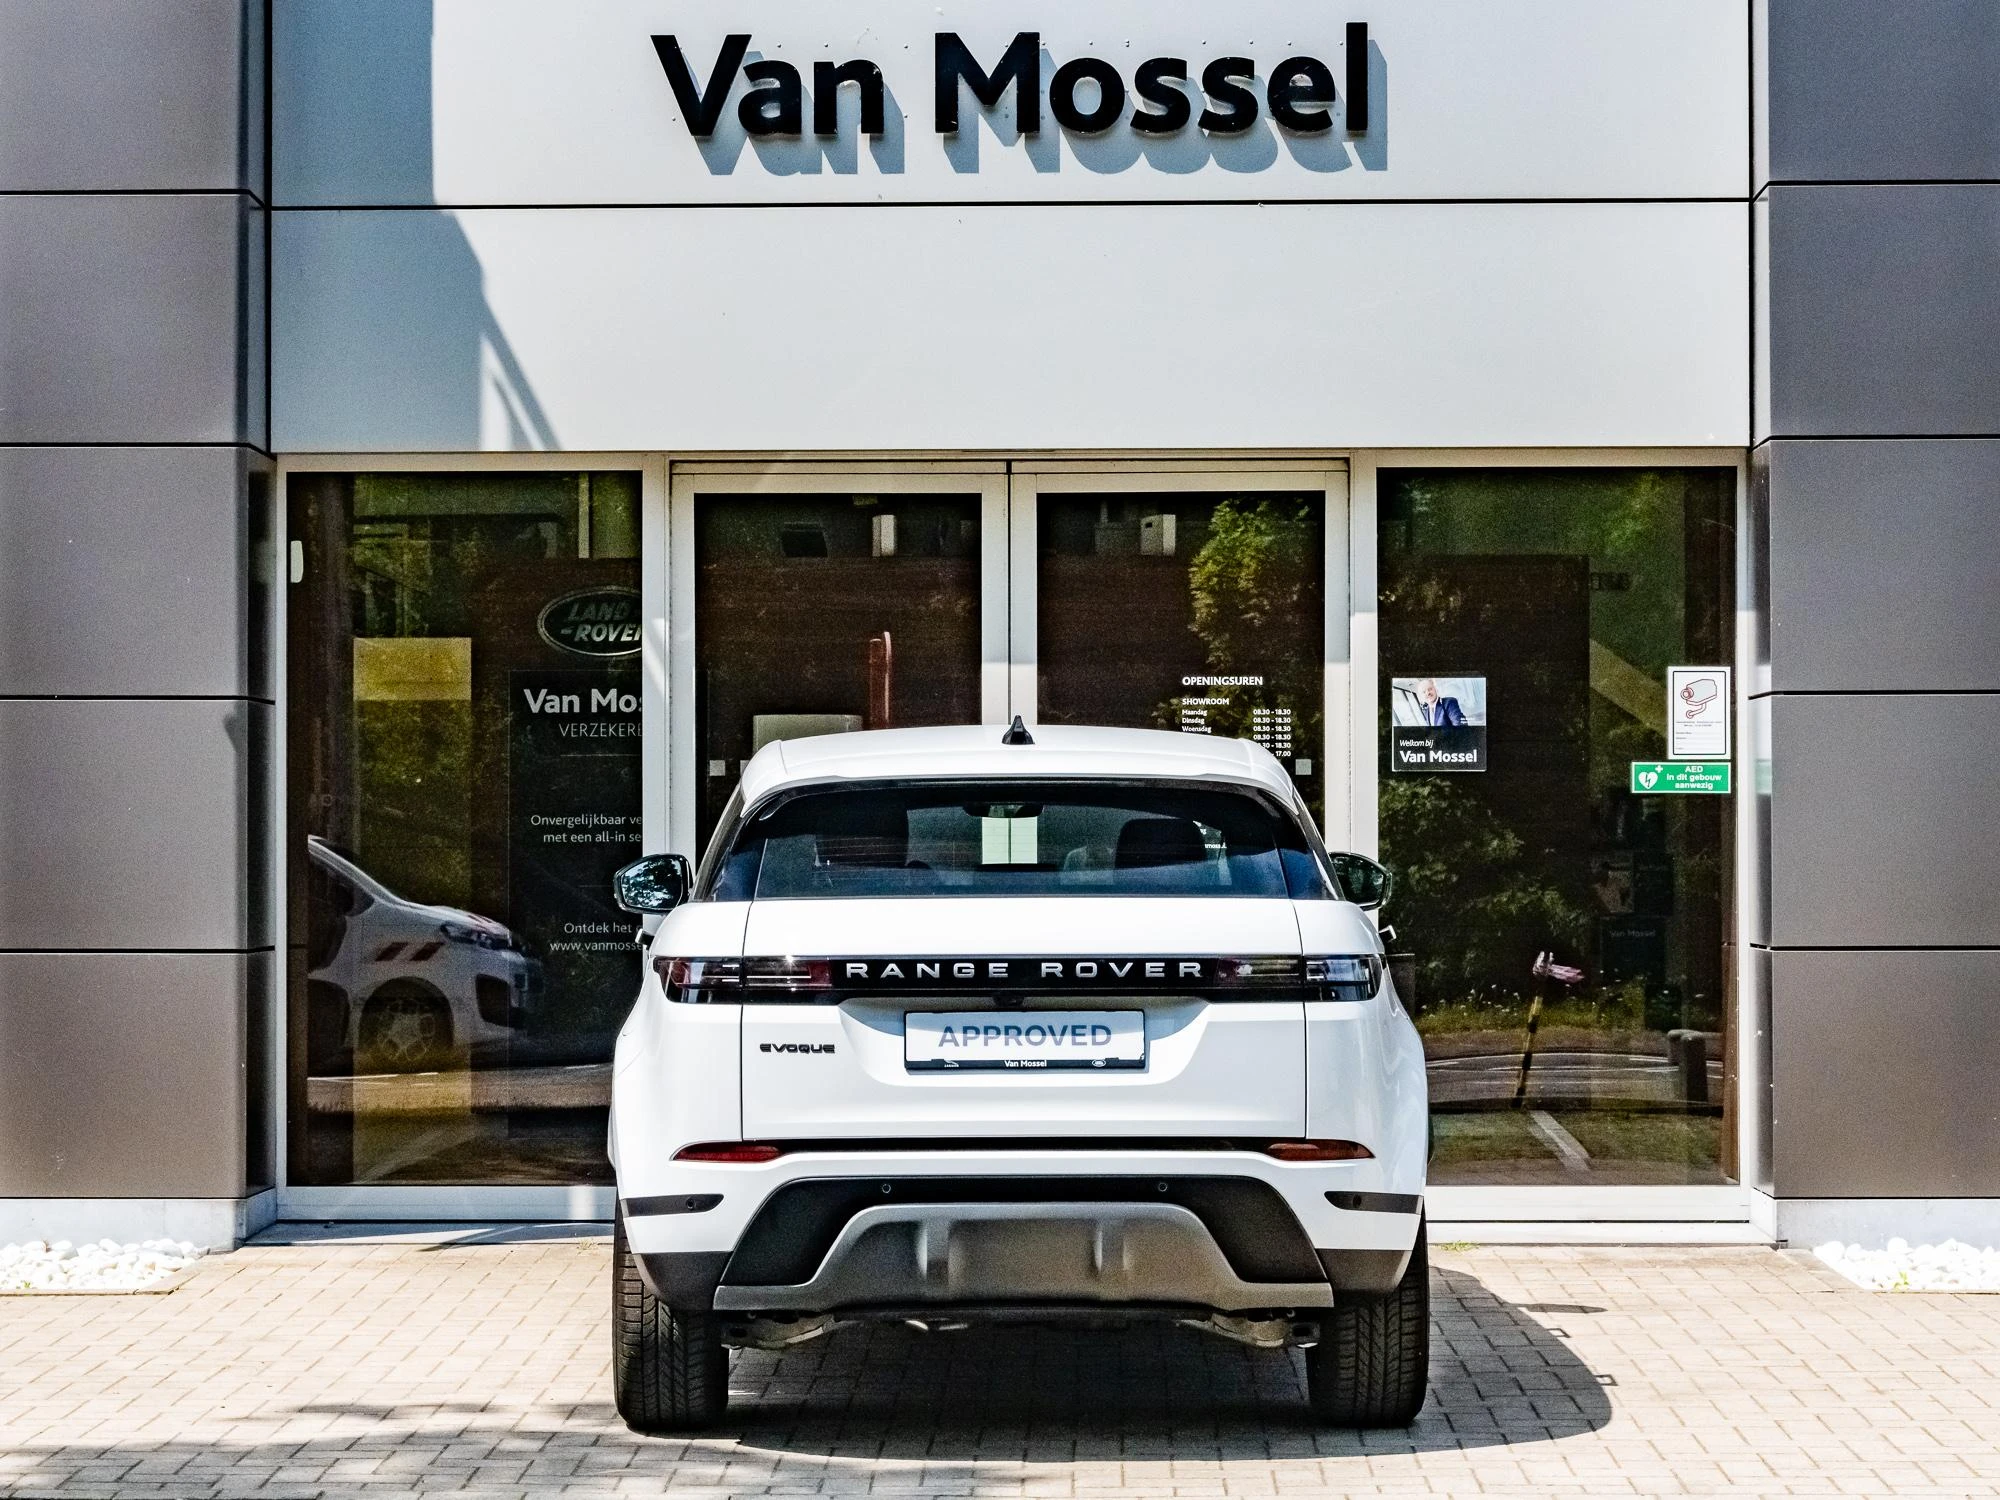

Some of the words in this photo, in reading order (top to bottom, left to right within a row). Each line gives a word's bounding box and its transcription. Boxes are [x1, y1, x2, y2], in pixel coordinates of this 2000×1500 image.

[651, 33, 884, 136] Van
[935, 21, 1368, 136] Mossel
[1182, 676, 1263, 686] OPENINGSUREN
[523, 688, 580, 713] Van
[1182, 708, 1208, 716] Maandag
[1181, 725, 1212, 733] Woensdag
[1400, 739, 1425, 747] Welkom
[1425, 739, 1434, 748] bij
[1400, 750, 1426, 763] Van
[1429, 749, 1477, 763] Mossel
[1685, 765, 1704, 773] AED
[1689, 773, 1722, 782] gebouw
[1675, 782, 1713, 790] aanwezig
[530, 813, 626, 829] Onvergelijkbaar
[543, 832, 568, 843] met
[570, 833, 592, 843] een
[595, 831, 626, 843] all-in
[563, 922, 609, 934] Ontdek
[612, 921, 632, 933] het
[846, 962, 1009, 979] RANGE
[1041, 961, 1203, 978] ROVER
[938, 1024, 1112, 1047] APPROVED
[760, 1043, 836, 1054] EVOQUE
[1020, 1059, 1047, 1067] Mossel
